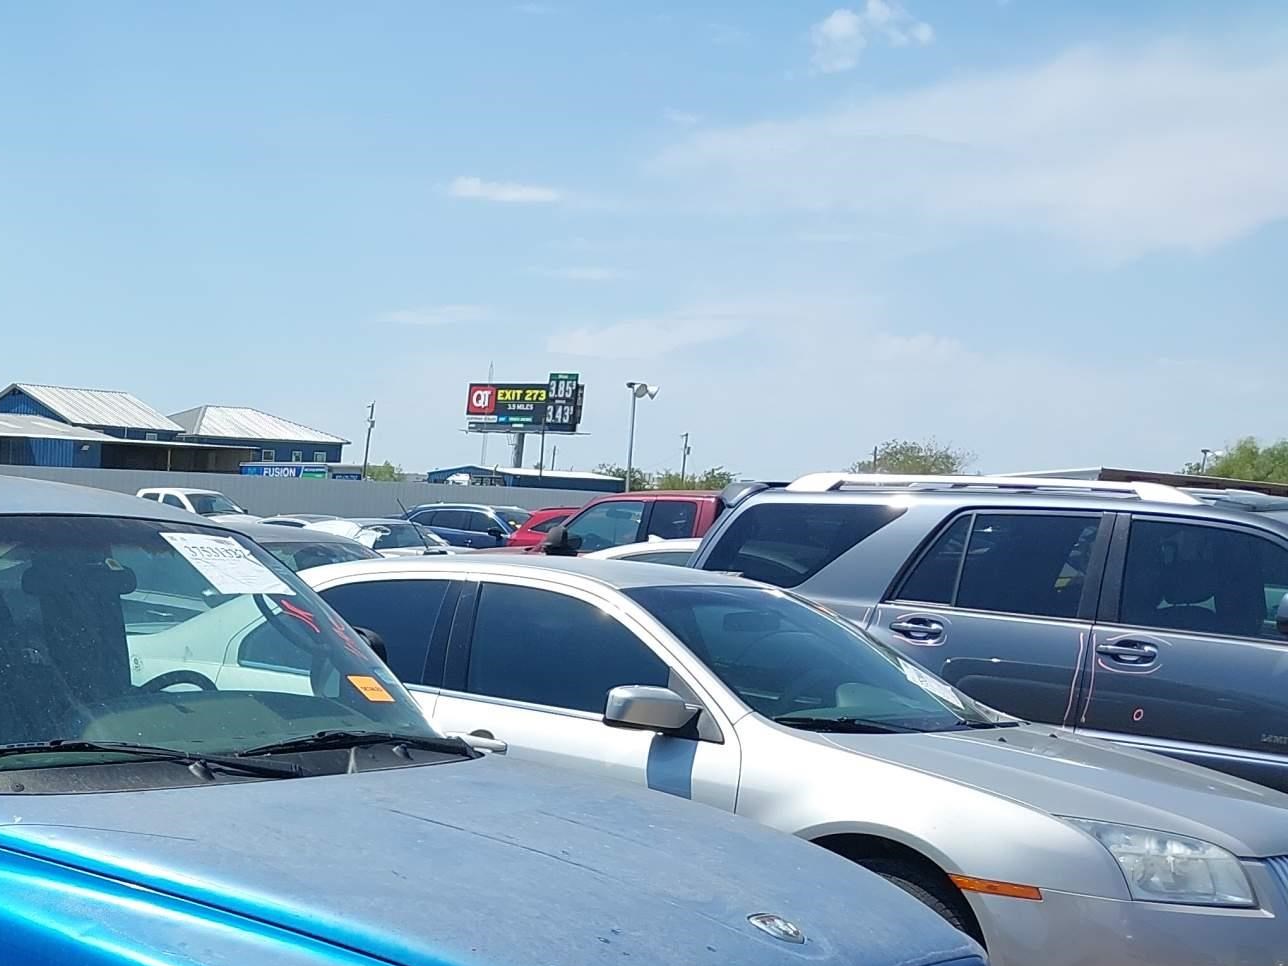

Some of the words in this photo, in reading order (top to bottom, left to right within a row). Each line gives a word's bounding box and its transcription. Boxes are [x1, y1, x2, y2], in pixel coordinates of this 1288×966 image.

[497, 389, 524, 401] EXIT
[524, 389, 547, 401] 273
[263, 467, 297, 478] FUSION
